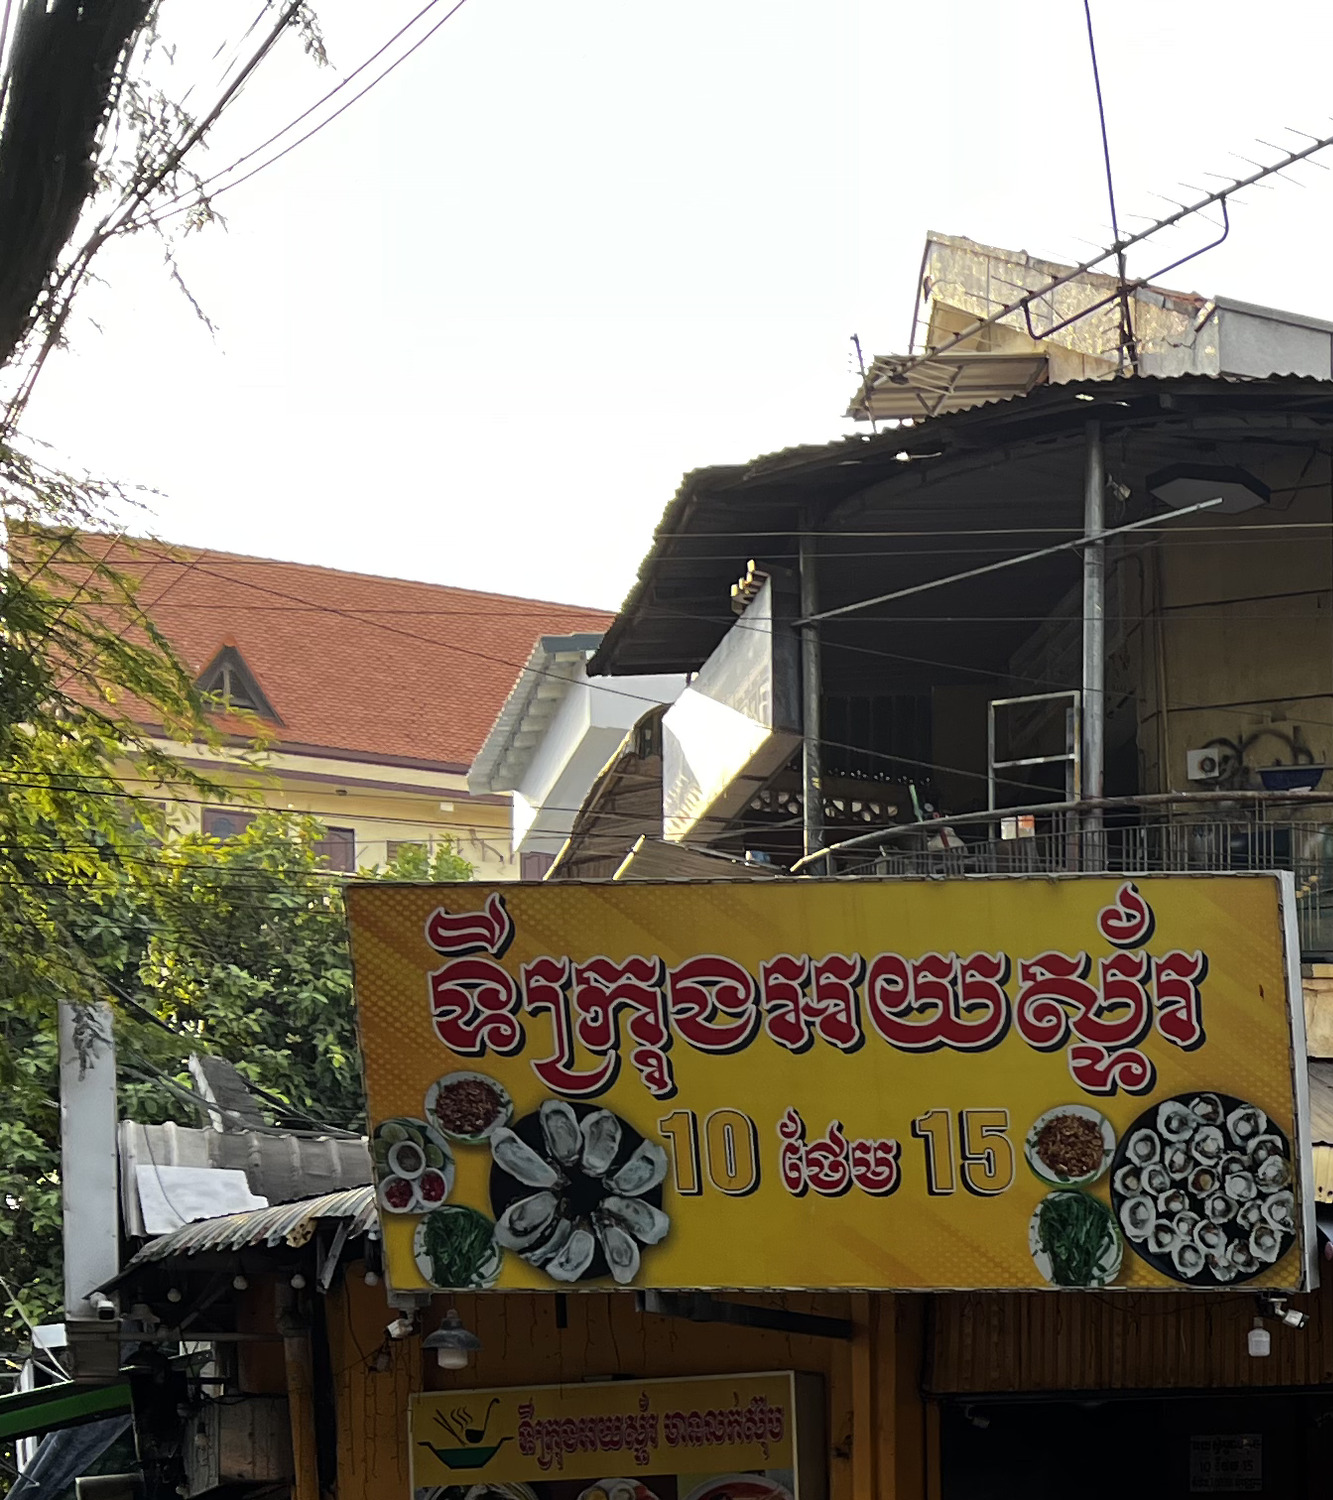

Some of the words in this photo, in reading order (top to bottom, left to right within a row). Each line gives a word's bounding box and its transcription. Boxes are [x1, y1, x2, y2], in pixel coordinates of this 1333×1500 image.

[425, 882, 1208, 1098] ទីក្រុងអយស្ទ័រ
[659, 1107, 759, 1198] 10
[911, 1107, 1016, 1198] 15
